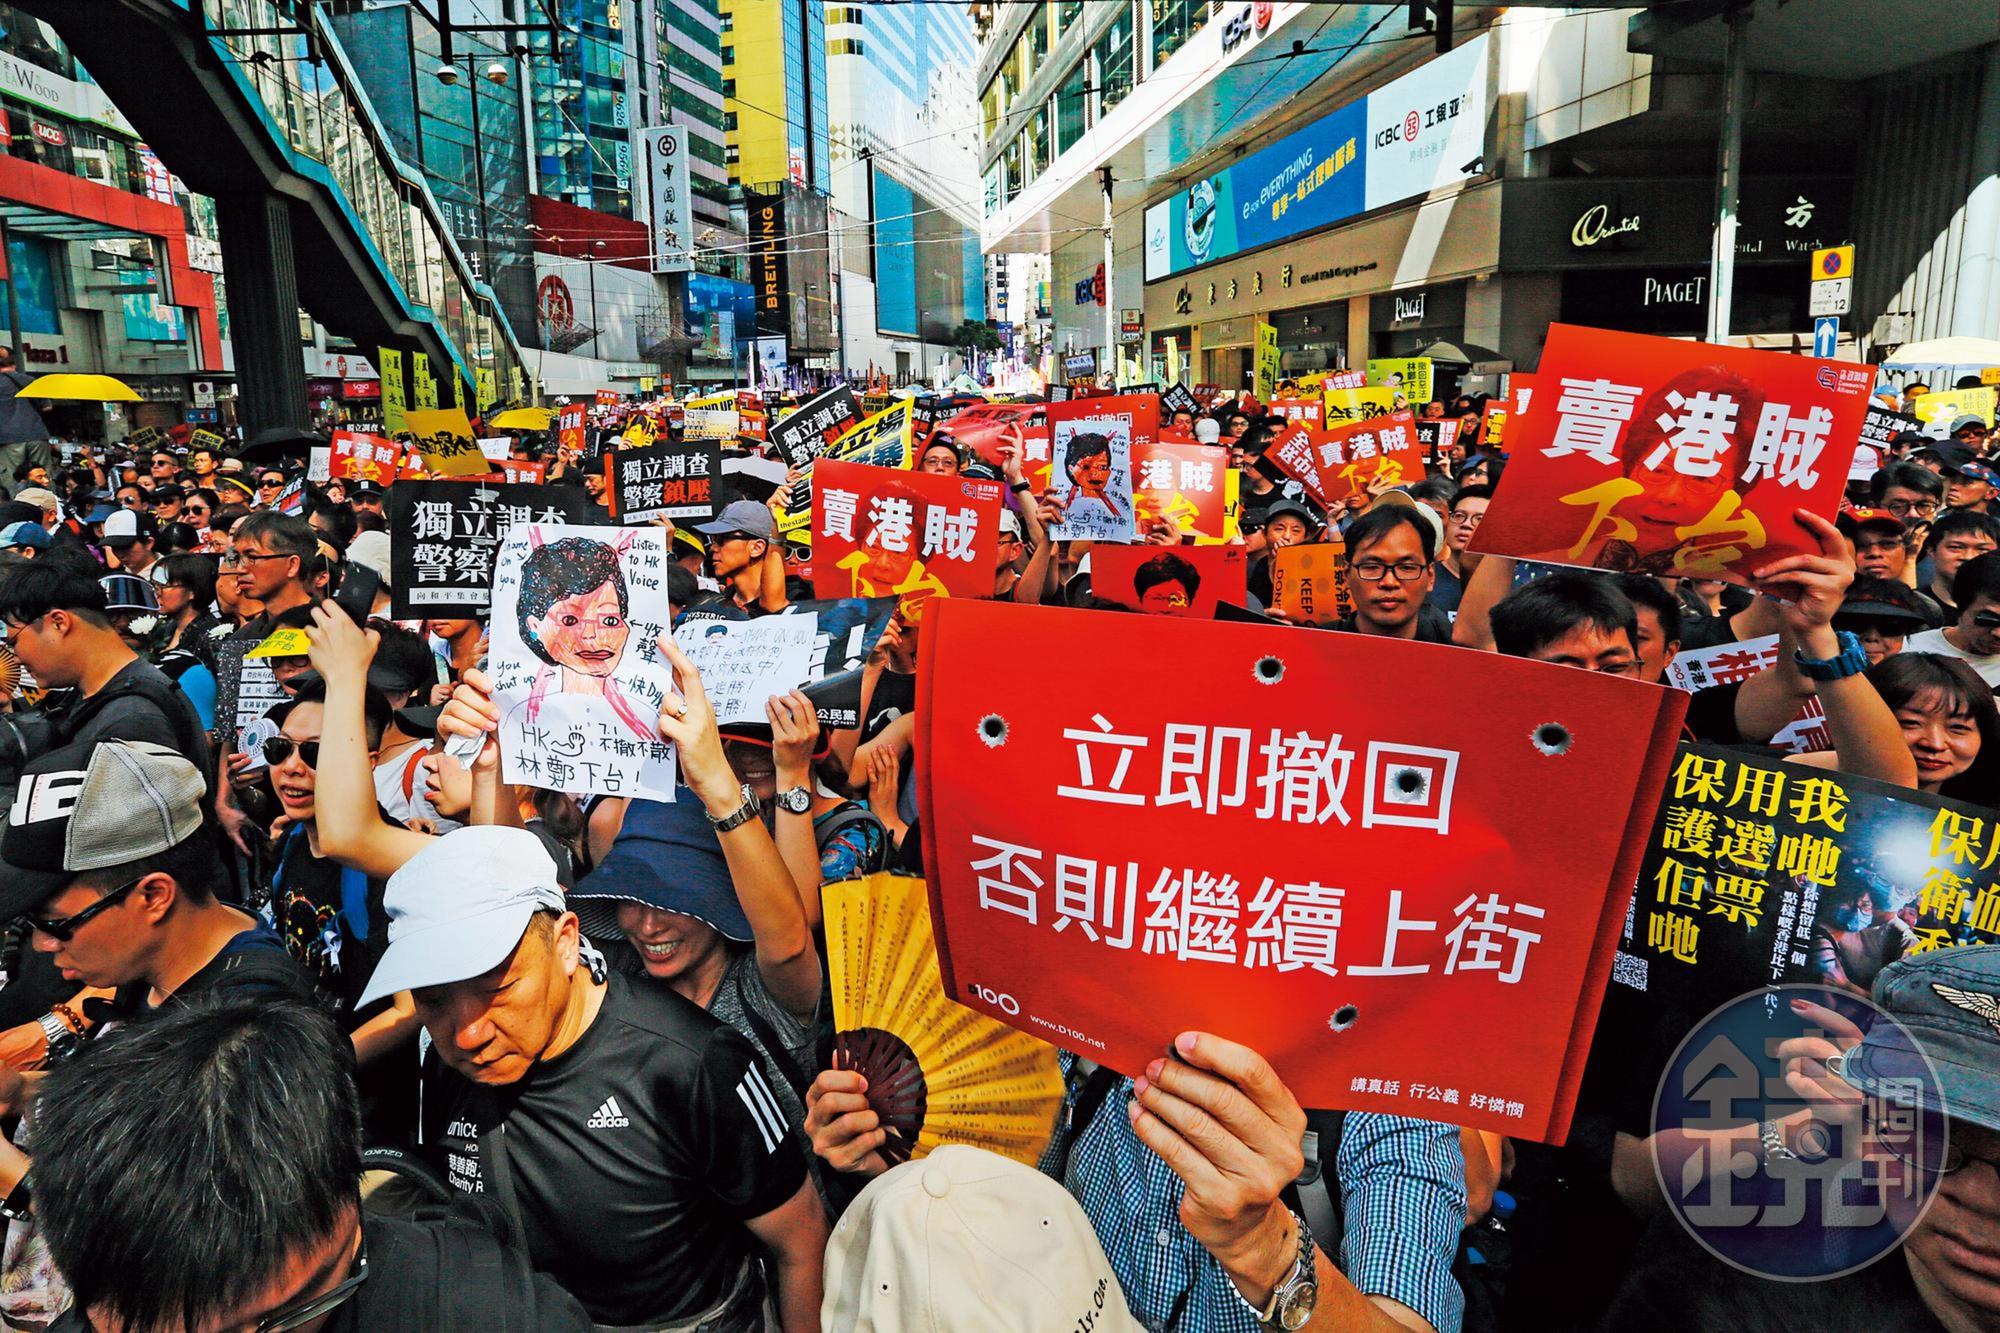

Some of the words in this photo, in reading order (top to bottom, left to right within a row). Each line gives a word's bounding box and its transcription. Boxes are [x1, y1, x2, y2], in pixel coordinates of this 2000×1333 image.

[1221, 4, 1253, 47] ICBC
[1375, 123, 1401, 150] ICBC
[1784, 195, 1816, 229] 方
[761, 206, 779, 309] BREITLING
[1644, 276, 1707, 306] PIAGET
[1836, 282, 1842, 293] 7
[1395, 293, 1426, 321] PIAGET
[1834, 299, 1846, 310] 12
[720, 399, 734, 412] UP
[782, 400, 853, 449] 獨立調查
[1541, 379, 1832, 491] 賣港賊
[336, 438, 395, 465] 賣港賊
[1318, 426, 1410, 468] 賣港賊
[622, 452, 711, 485] 獨立調查
[1139, 459, 1214, 492] 港賊
[623, 478, 712, 511] 警察鎮壓
[821, 488, 979, 563] 賣港賊
[1559, 477, 1767, 574] 下台
[628, 554, 639, 566] to
[644, 556, 660, 568] HK
[631, 539, 661, 551] Listen
[412, 543, 492, 584] 警察
[629, 568, 660, 591] Voice
[1274, 568, 1285, 610] DON'
[1300, 578, 1314, 615] KEEP
[495, 676, 518, 692] shut
[523, 674, 537, 690] up
[598, 722, 619, 736] 7.1
[816, 708, 857, 722] 公民黨
[521, 722, 551, 752] HK
[1057, 711, 1461, 836] 立即撤回
[1705, 763, 1788, 928] 用選票
[1776, 777, 1851, 888] 我哋
[1647, 752, 1729, 964] 保護佢哋
[969, 833, 1546, 985] 否則繼續上街
[1790, 886, 1821, 967] 你想留低一個
[1030, 1014, 1106, 1050] www.D100.net
[1350, 1076, 1401, 1096] 講真話
[1409, 1083, 1460, 1105] 行公義
[1469, 1093, 1525, 1119] 好憐憫
[587, 1115, 629, 1129] adidas
[448, 1171, 475, 1194] Charity
